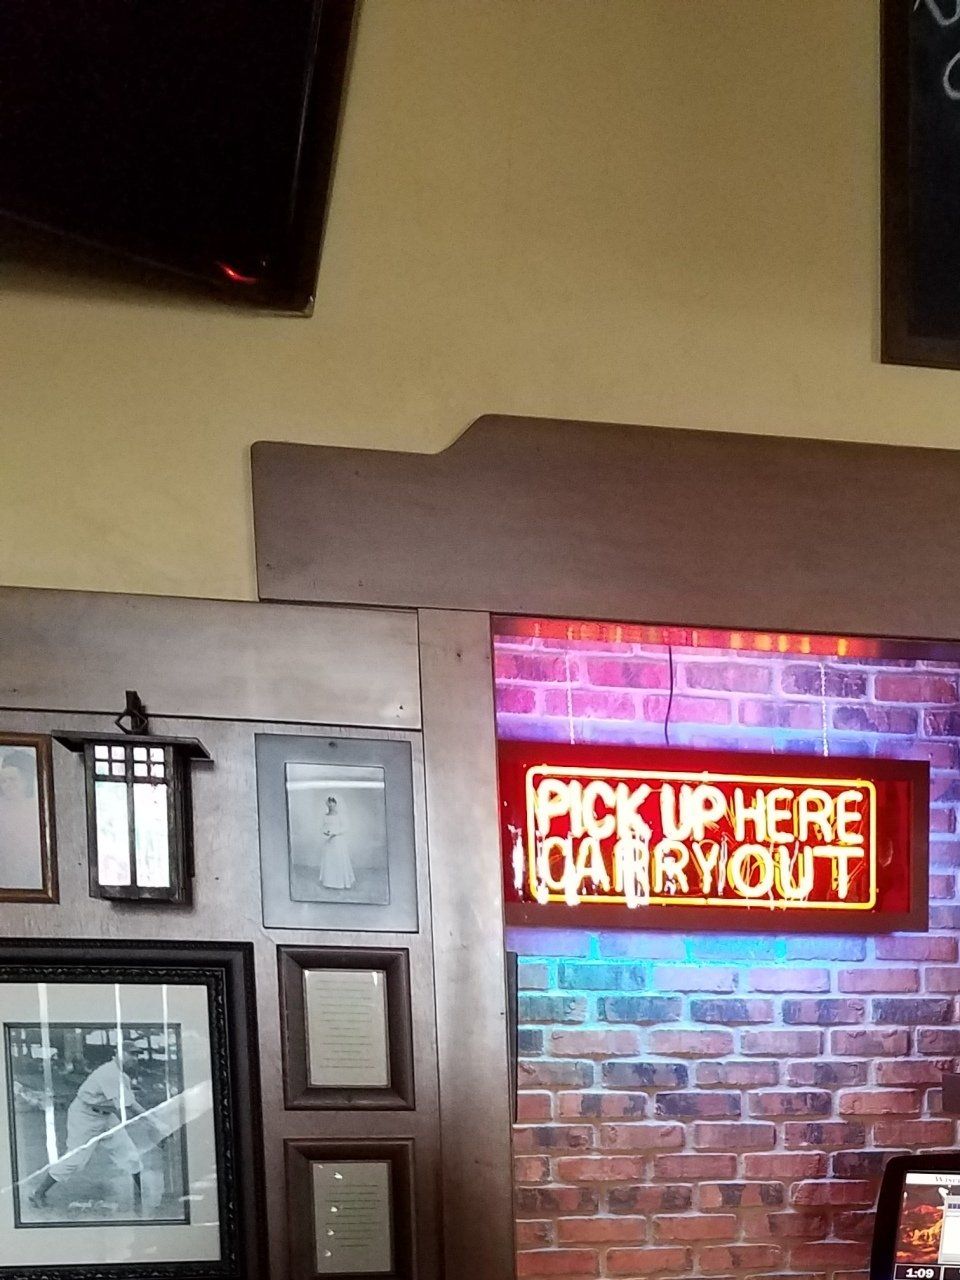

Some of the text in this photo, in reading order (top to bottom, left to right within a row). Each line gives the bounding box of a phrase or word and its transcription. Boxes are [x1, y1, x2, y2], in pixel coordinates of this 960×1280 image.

[537, 779, 865, 845] PICK UP HERE
[541, 835, 865, 899] CARRY OUT
[905, 1267, 934, 1279] 1:09
